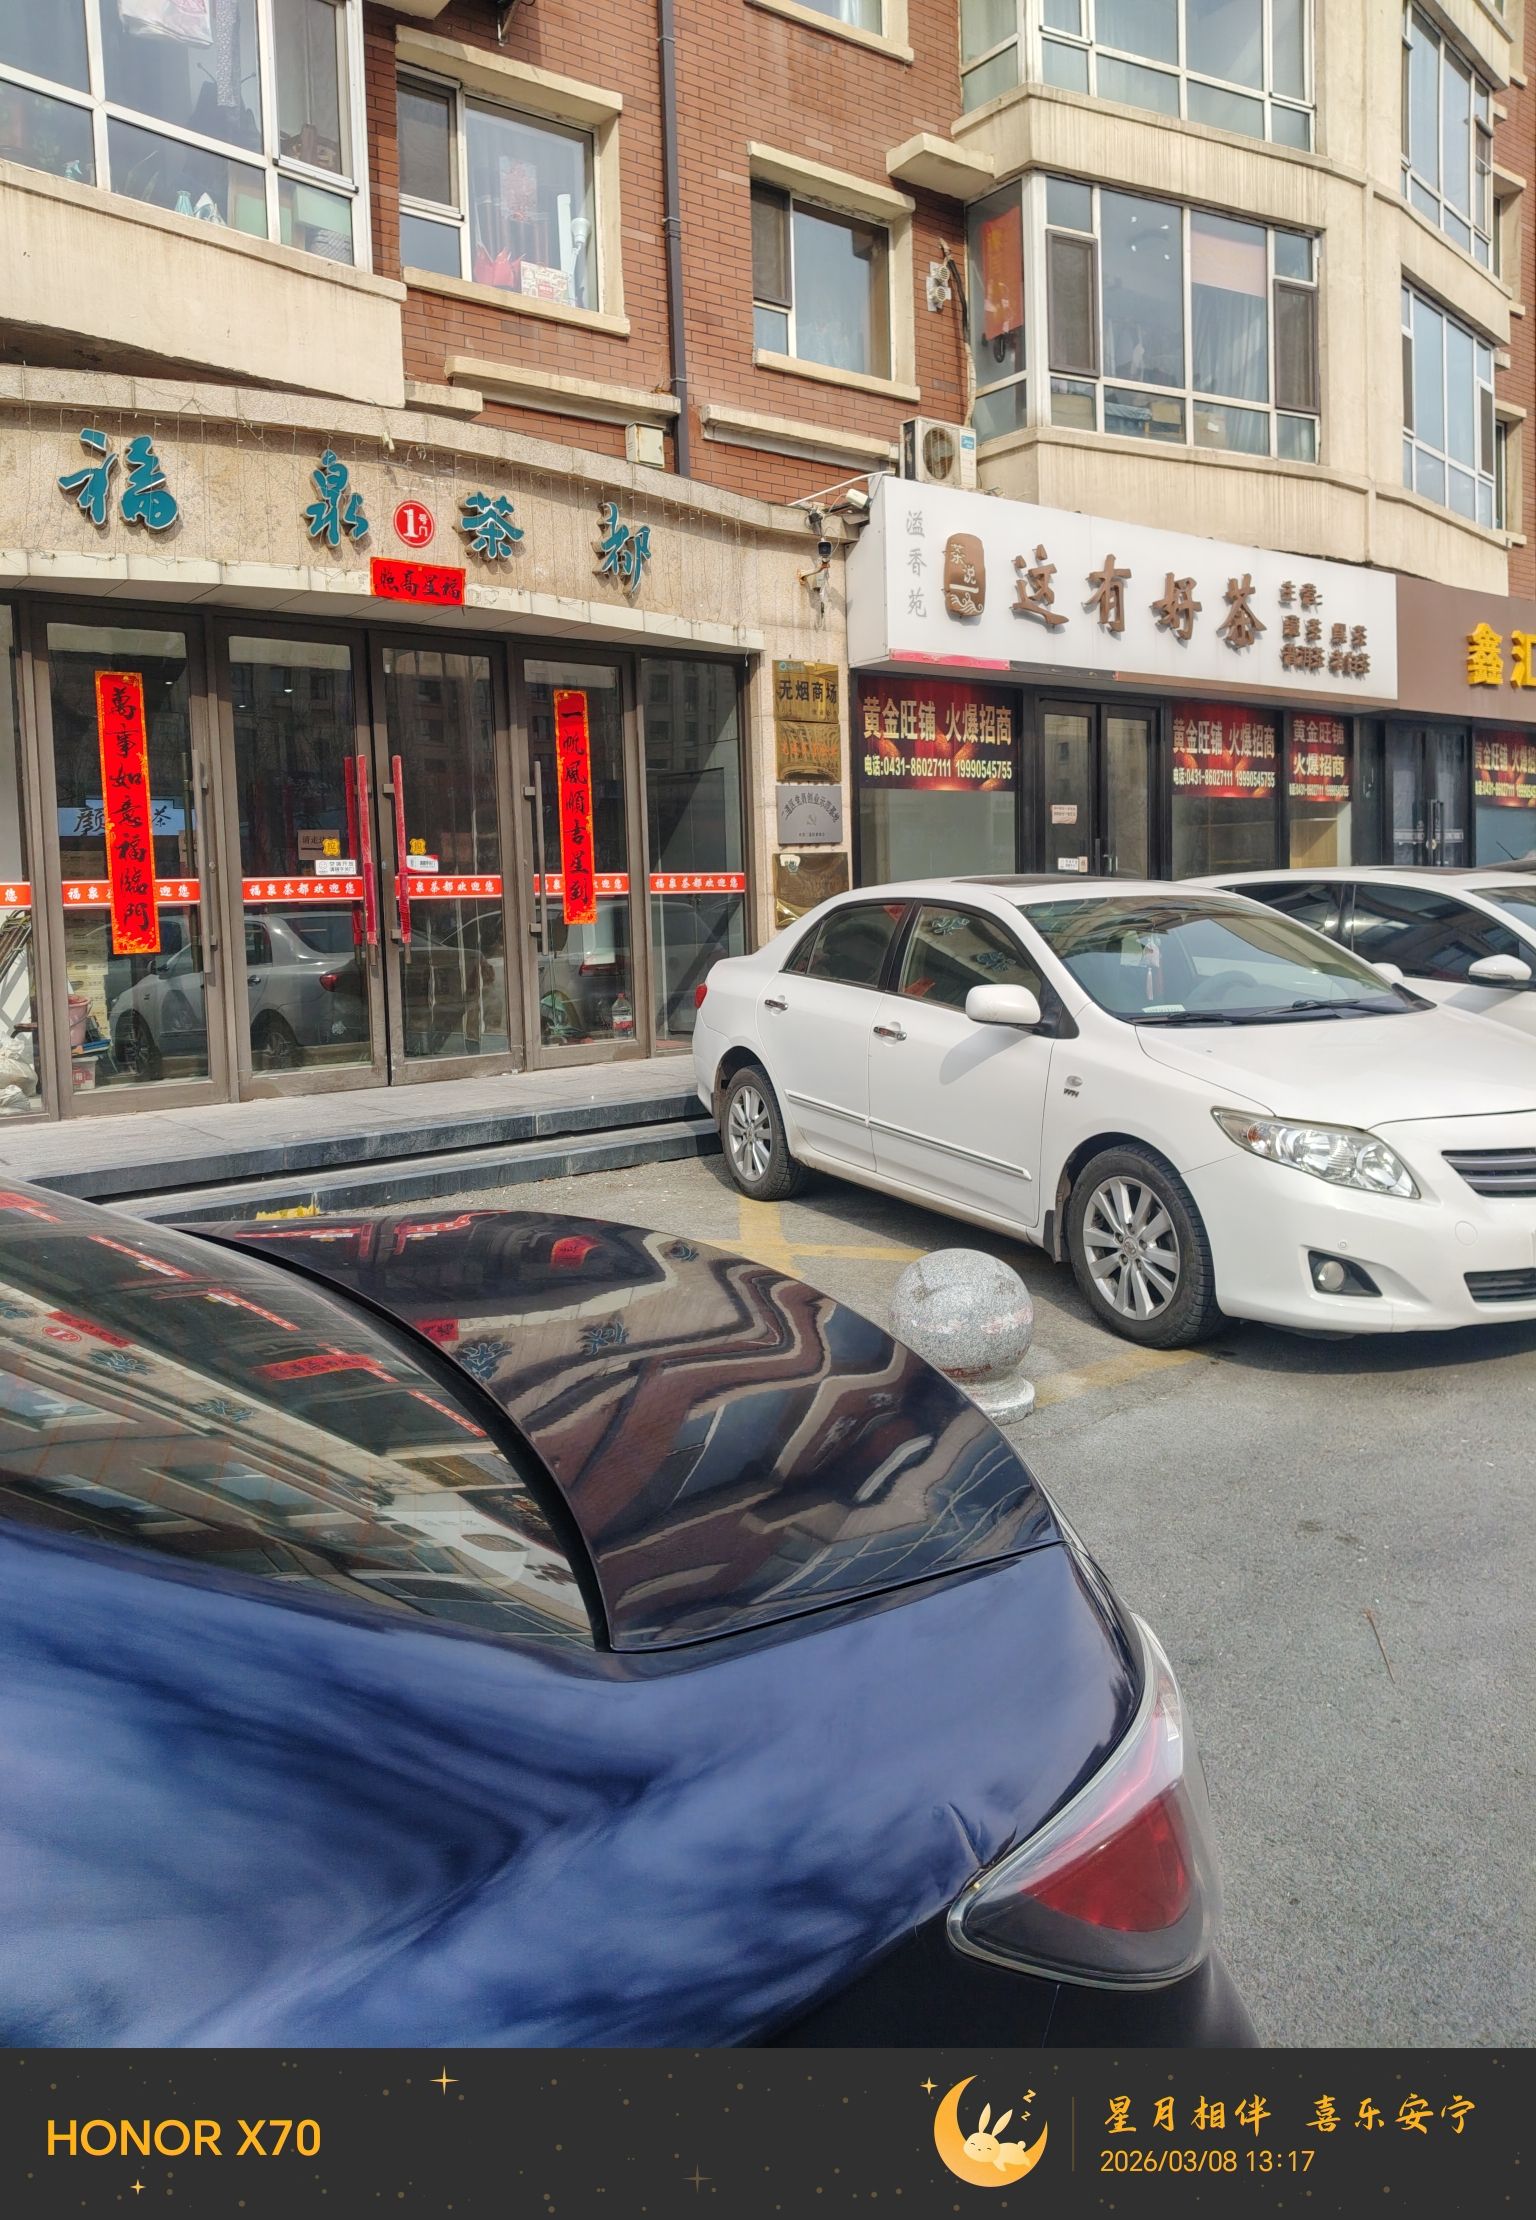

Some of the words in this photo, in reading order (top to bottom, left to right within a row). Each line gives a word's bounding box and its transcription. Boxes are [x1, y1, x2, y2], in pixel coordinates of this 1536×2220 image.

[58, 427, 651, 596] 福泉茶都
[403, 508, 428, 538] 1号门
[906, 510, 927, 618] 溢香苑
[1010, 543, 1266, 649] 这有好茶
[778, 679, 838, 705] 无烟商场
[863, 696, 936, 741] 黄金旺铺
[945, 702, 1012, 746] 火爆招商
[1293, 719, 1345, 745] 黄金旺铺
[1172, 718, 1223, 755] 黄金旺铺
[1228, 721, 1275, 759] 火爆招商
[864, 754, 951, 777] 电话:0431-86027111
[956, 759, 1012, 780] 19990545755
[1293, 753, 1345, 779] 火爆招商
[5, 888, 18, 902] 您
[249, 882, 356, 897] 福泉茶都欢迎您
[408, 880, 495, 894] 泉茶都欢迎您
[655, 876, 738, 889] 福泉茶都欢迎您
